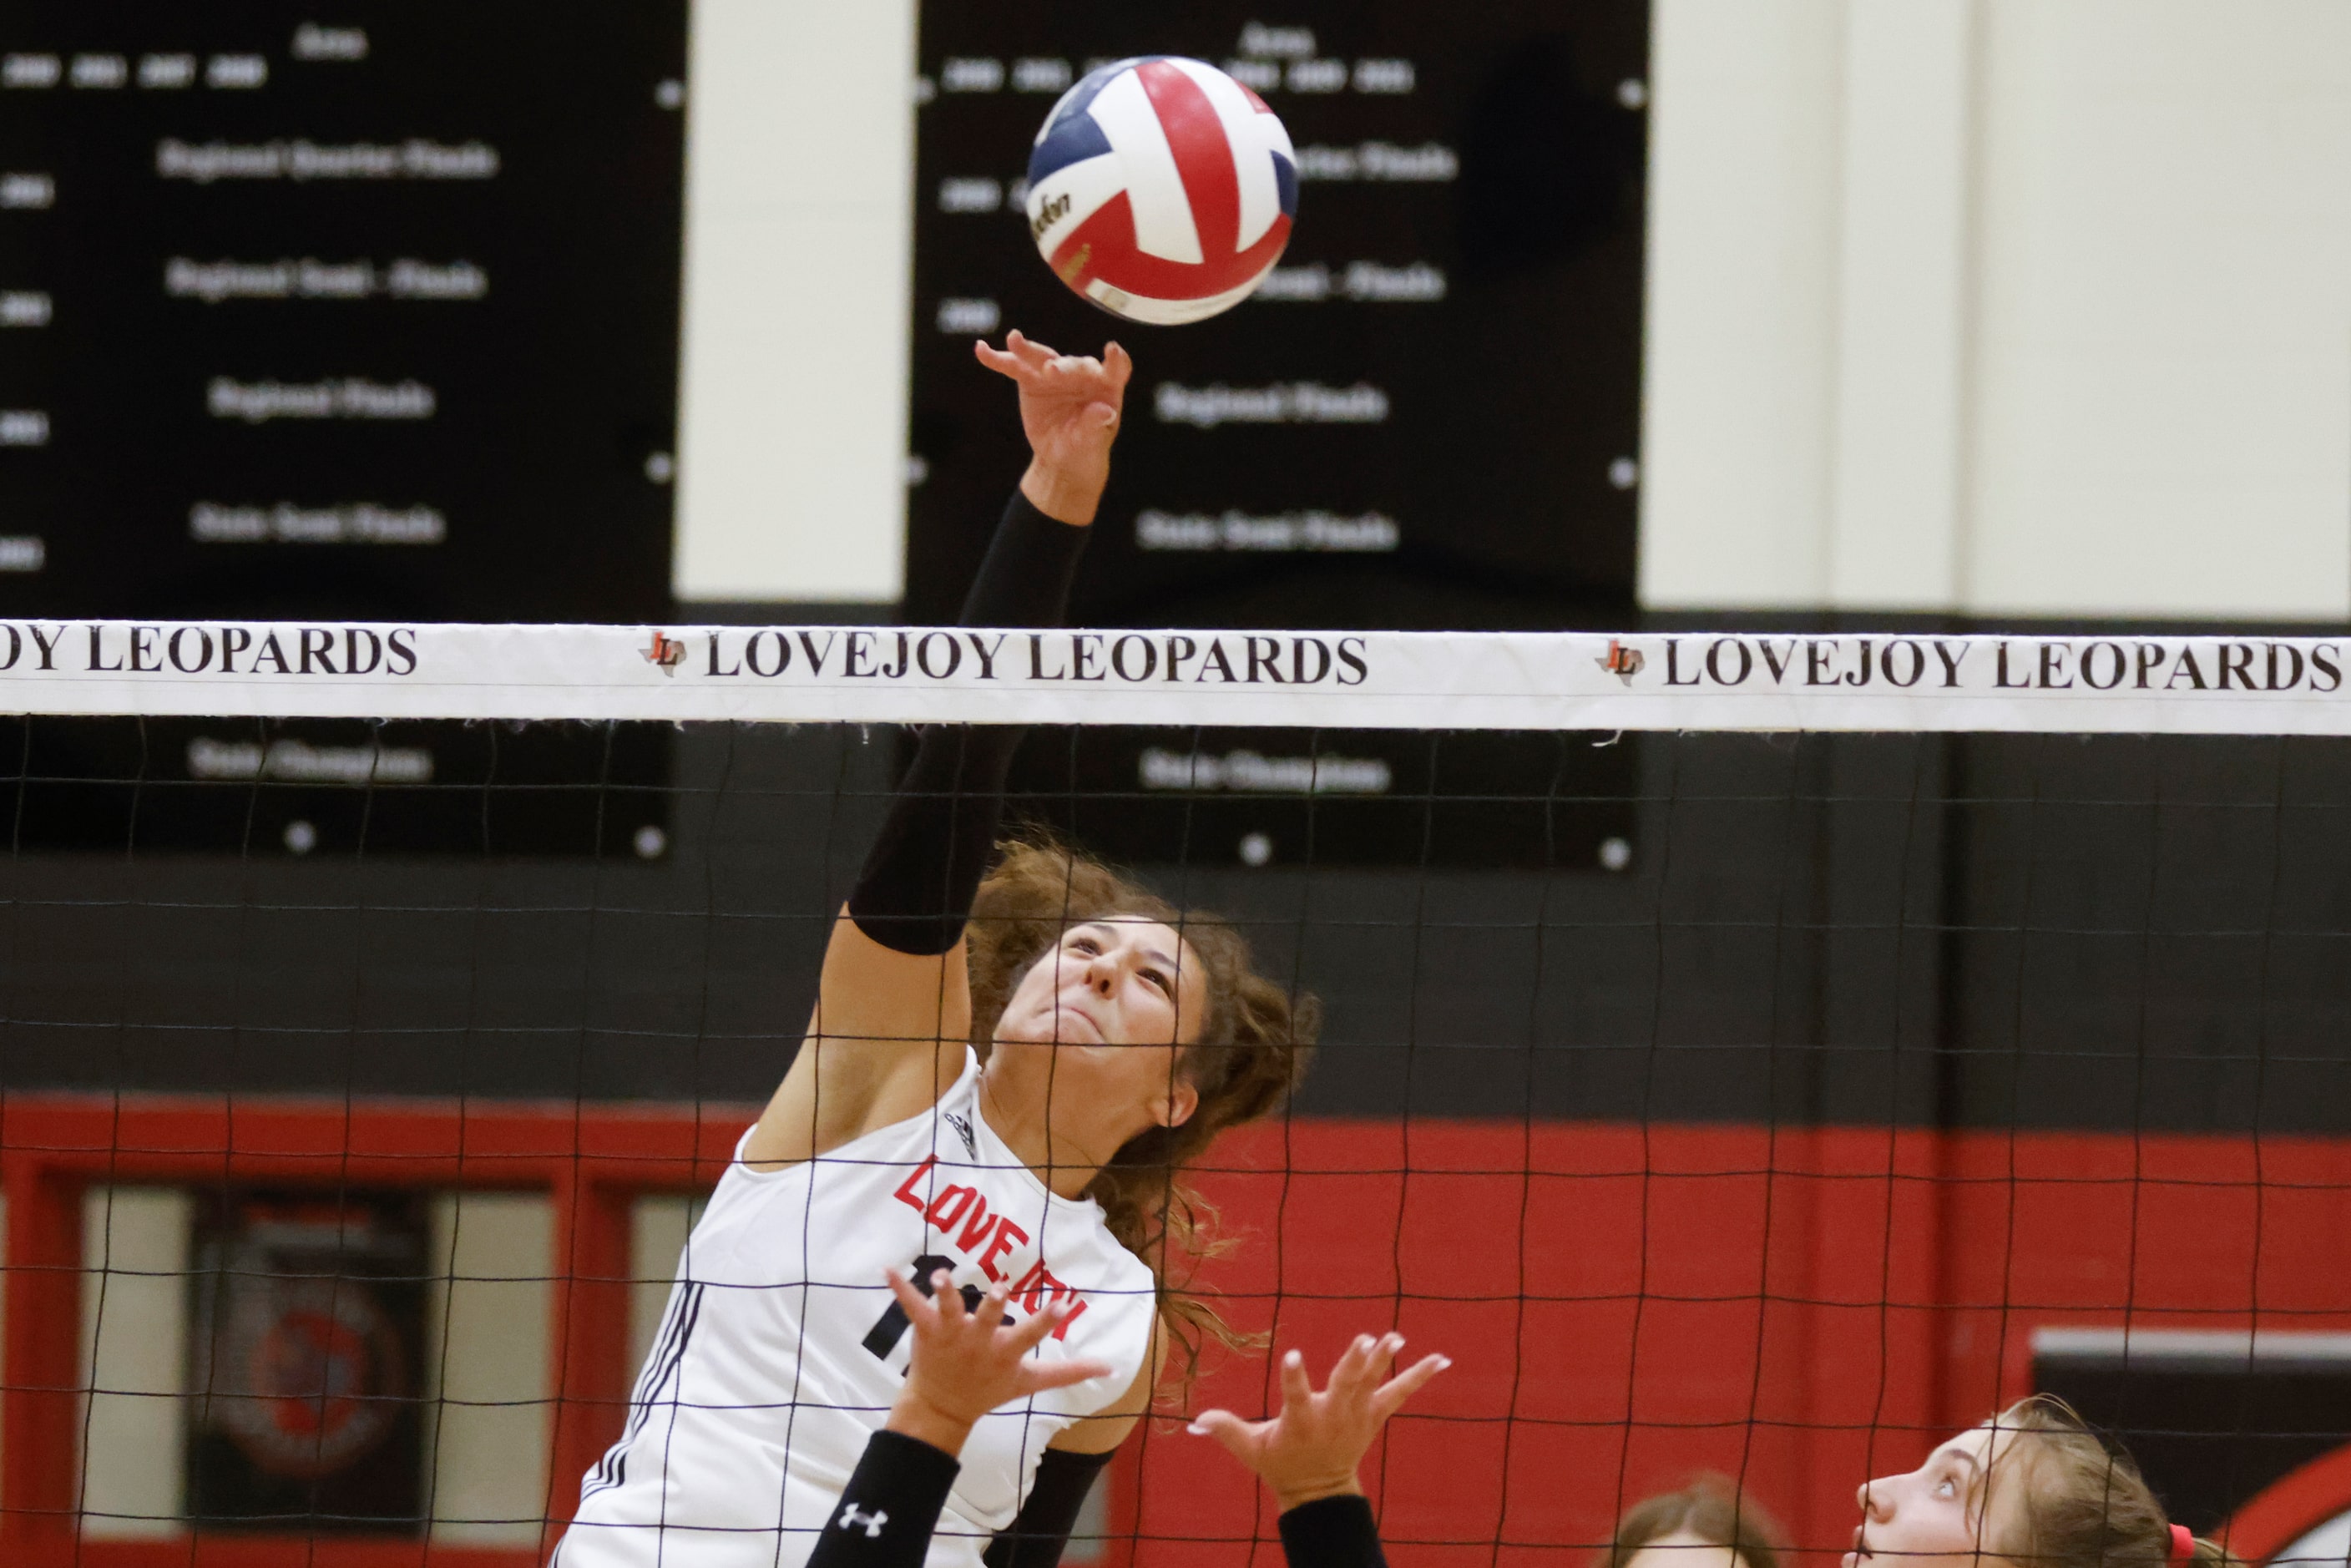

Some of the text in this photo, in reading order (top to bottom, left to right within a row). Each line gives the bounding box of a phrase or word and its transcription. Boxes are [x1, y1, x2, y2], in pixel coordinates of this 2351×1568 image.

[84, 625, 417, 675] LEOPARDS
[704, 630, 1009, 680] LOVEJOY
[1026, 634, 1368, 685] LEOPARDS
[1662, 637, 1974, 688] LOVEJOY
[1991, 641, 2343, 692] LEOPARDS
